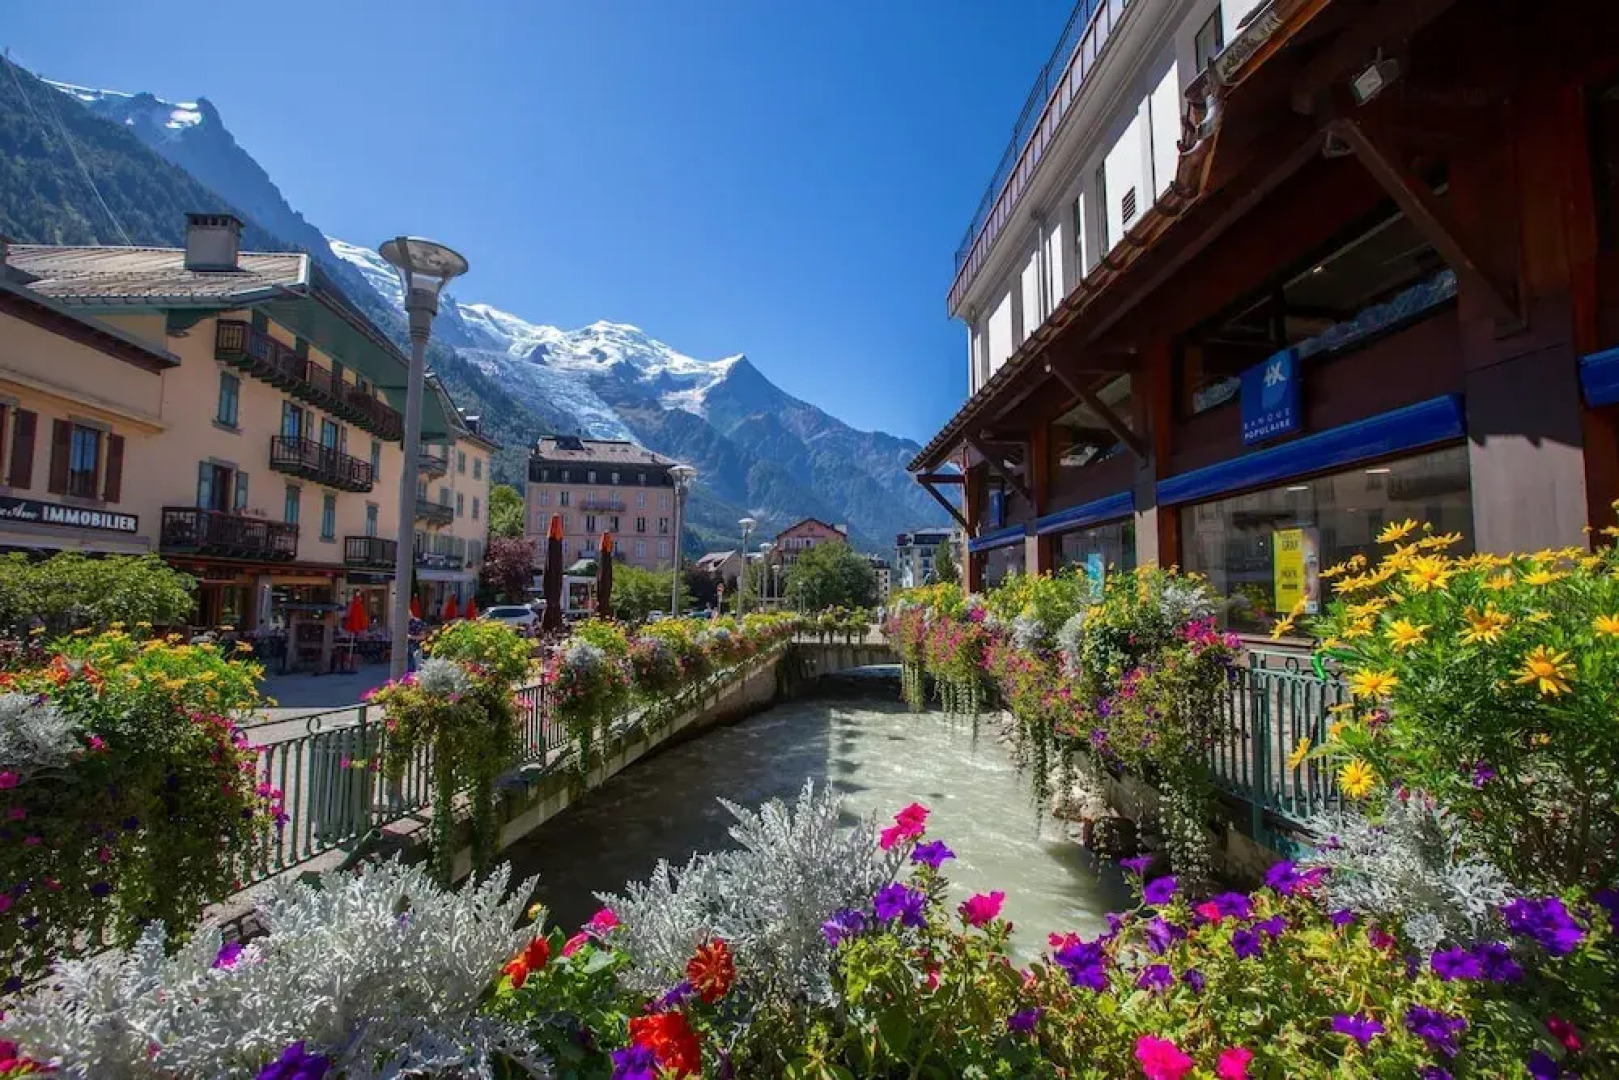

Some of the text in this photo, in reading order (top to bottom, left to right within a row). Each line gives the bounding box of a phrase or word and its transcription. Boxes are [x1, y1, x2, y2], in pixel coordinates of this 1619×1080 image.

[1244, 407, 1290, 429] BANQUE
[1244, 417, 1290, 439] POPULAIRE
[42, 506, 136, 531] IMMOBILIER
